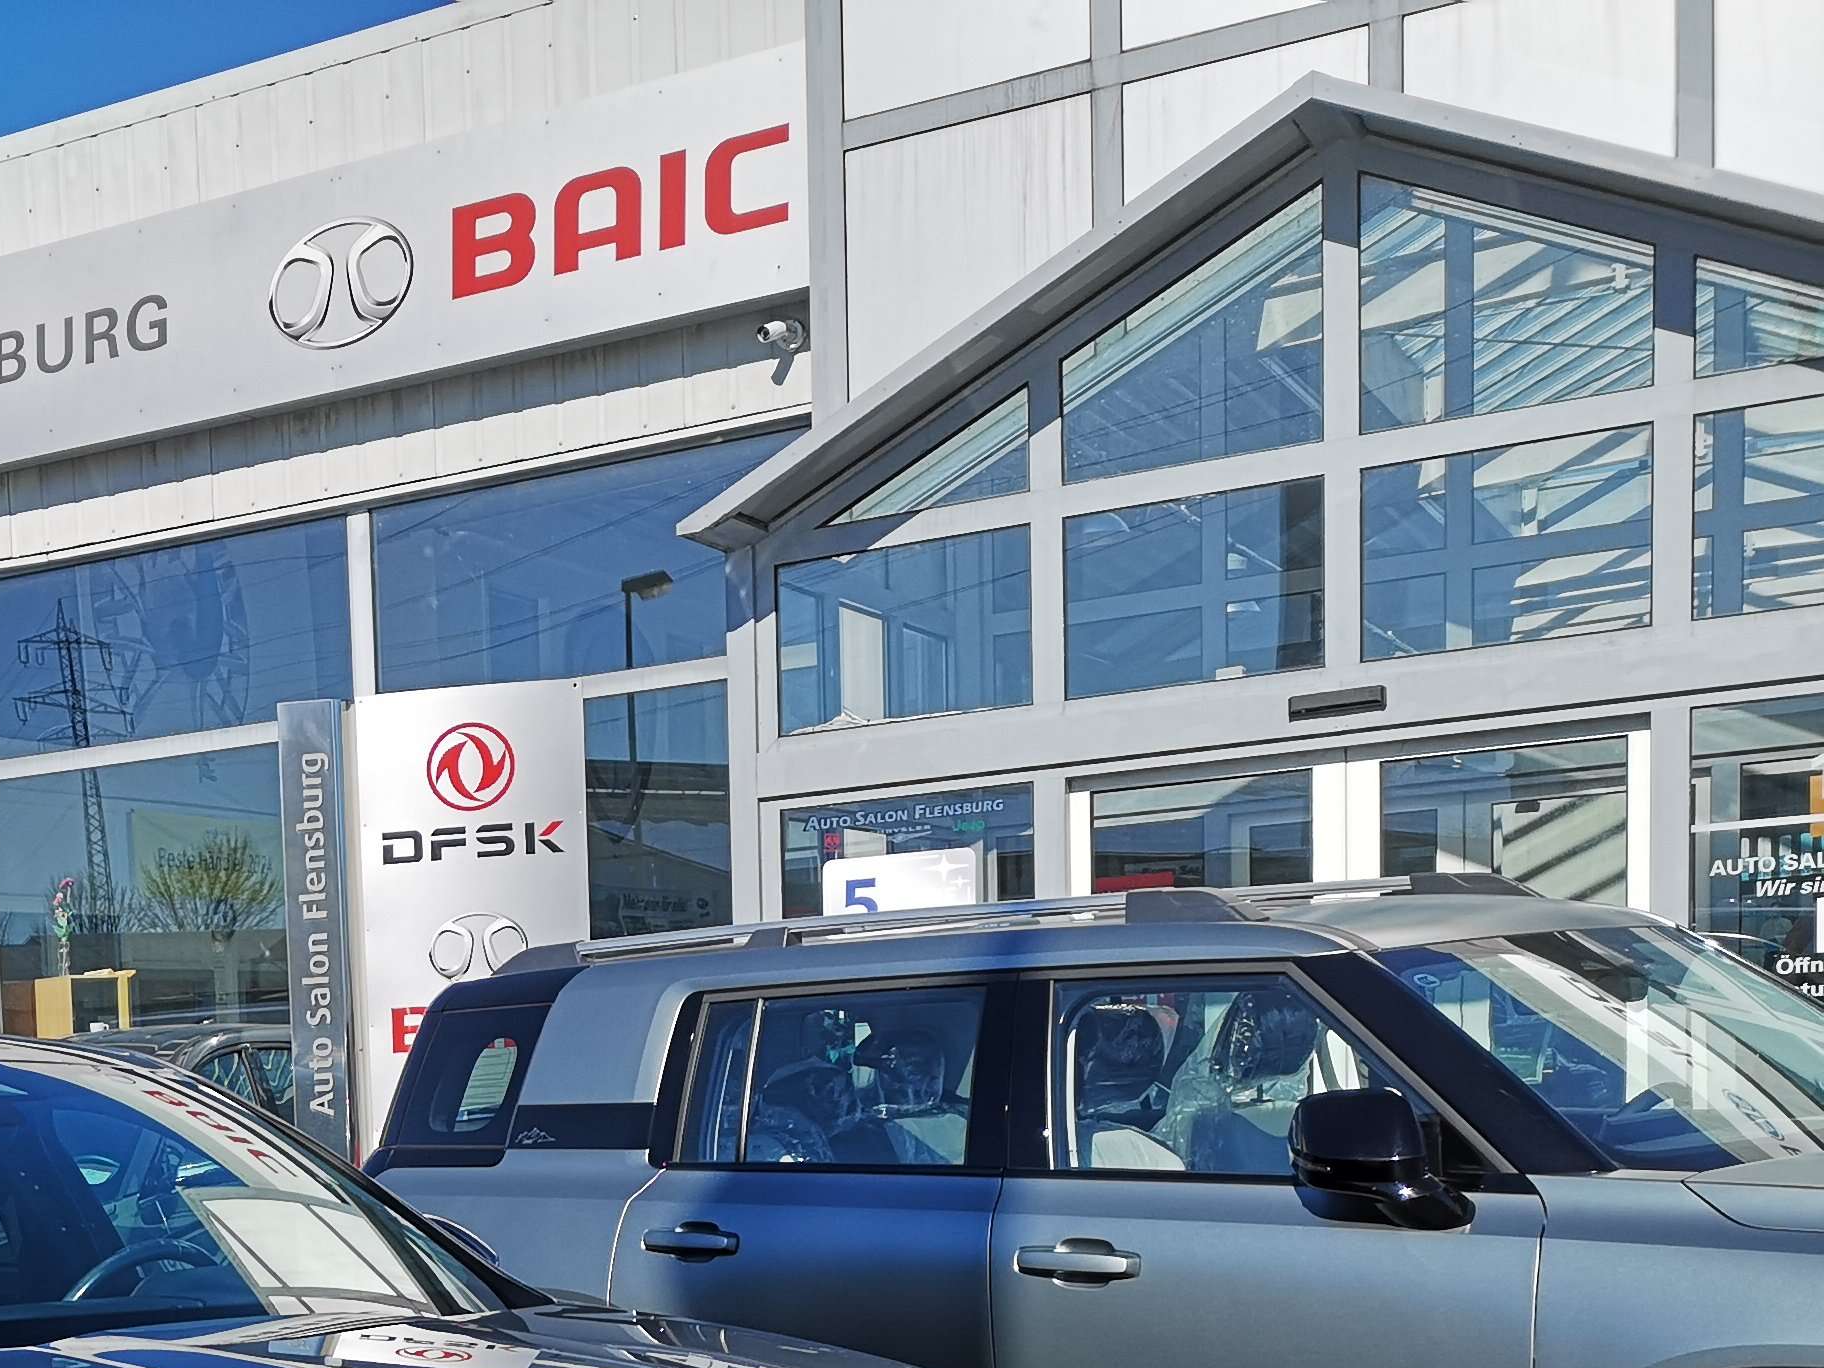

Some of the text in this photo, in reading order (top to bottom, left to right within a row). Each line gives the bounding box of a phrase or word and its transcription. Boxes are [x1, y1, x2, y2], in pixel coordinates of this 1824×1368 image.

[452, 122, 790, 300] BAIC
[803, 799, 1005, 832] AUTO SALON FLENSBURG
[381, 819, 565, 865] DFSK
[1709, 856, 1776, 877] AUTO
[844, 877, 878, 913] 5
[1756, 879, 1796, 898] Wir
[295, 752, 337, 1117] Auto Salon Flensburg
